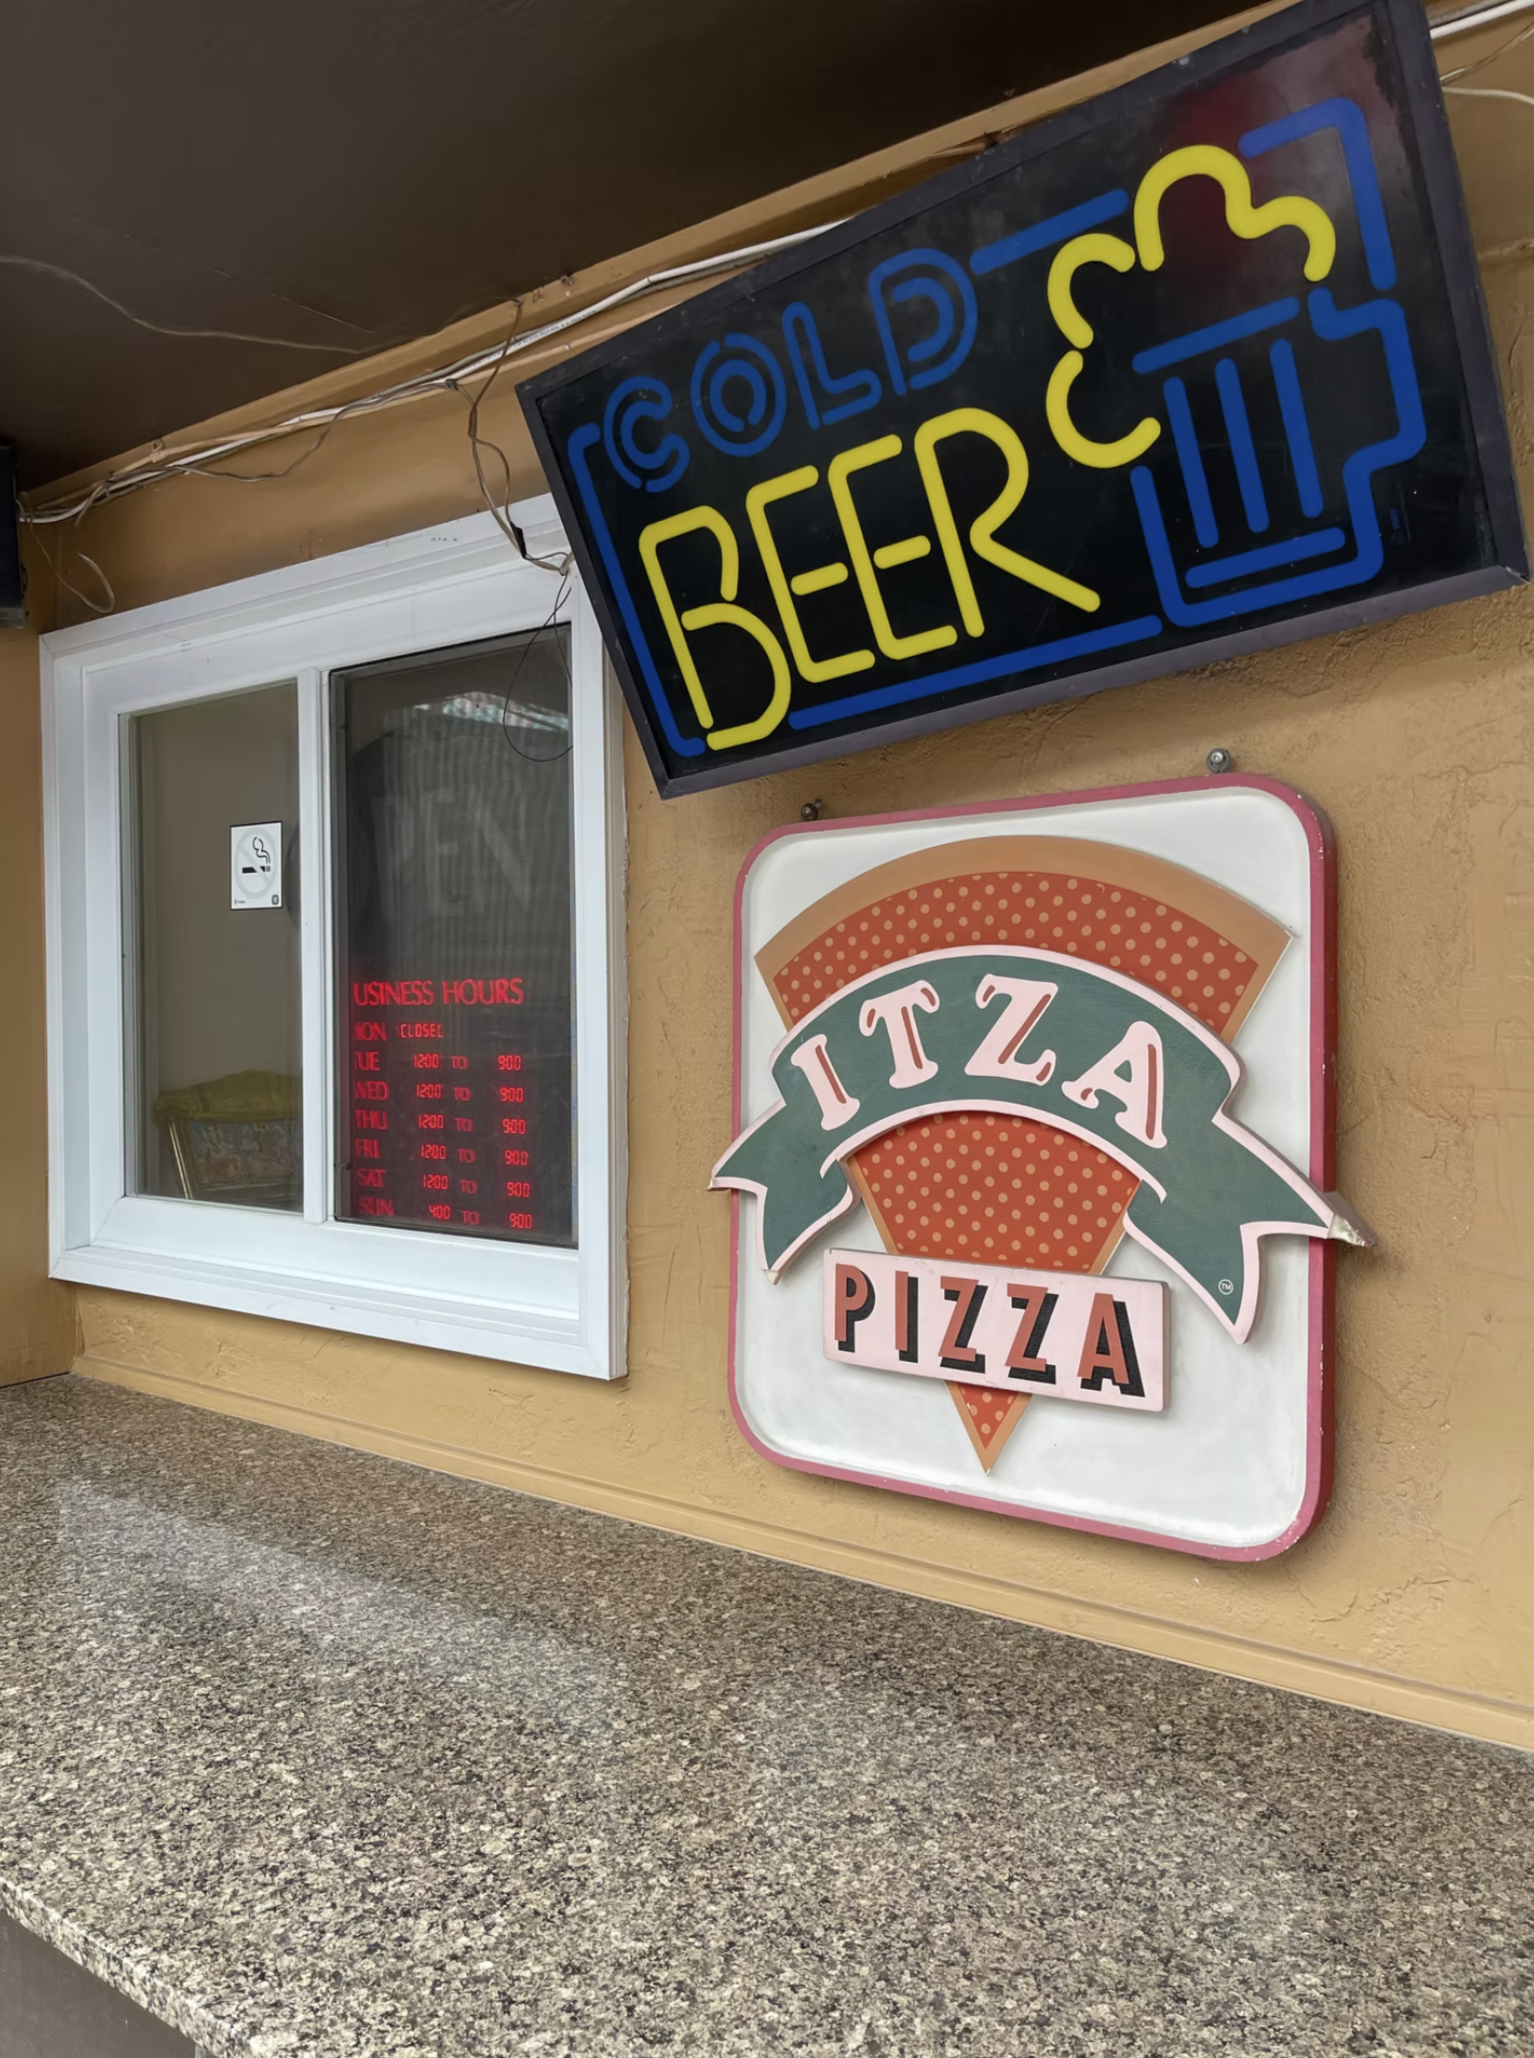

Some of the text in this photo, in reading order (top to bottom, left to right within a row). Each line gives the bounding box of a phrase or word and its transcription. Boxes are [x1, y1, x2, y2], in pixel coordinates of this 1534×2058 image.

[605, 248, 977, 493] COLD
[638, 407, 1101, 751] BEER
[353, 978, 523, 1006] USINESS HOURS
[450, 1055, 469, 1070] TO
[790, 973, 1167, 1148] ITZA
[453, 1086, 472, 1101] TO
[355, 1108, 388, 1130] THU
[454, 1117, 473, 1132] TO
[355, 1139, 380, 1158] FRI
[457, 1148, 476, 1163] TO
[358, 1168, 385, 1187] SAT
[460, 1179, 478, 1193] TO
[360, 1197, 394, 1216] SUN
[462, 1210, 480, 1225] TO
[834, 1263, 1145, 1398] PIZZA
